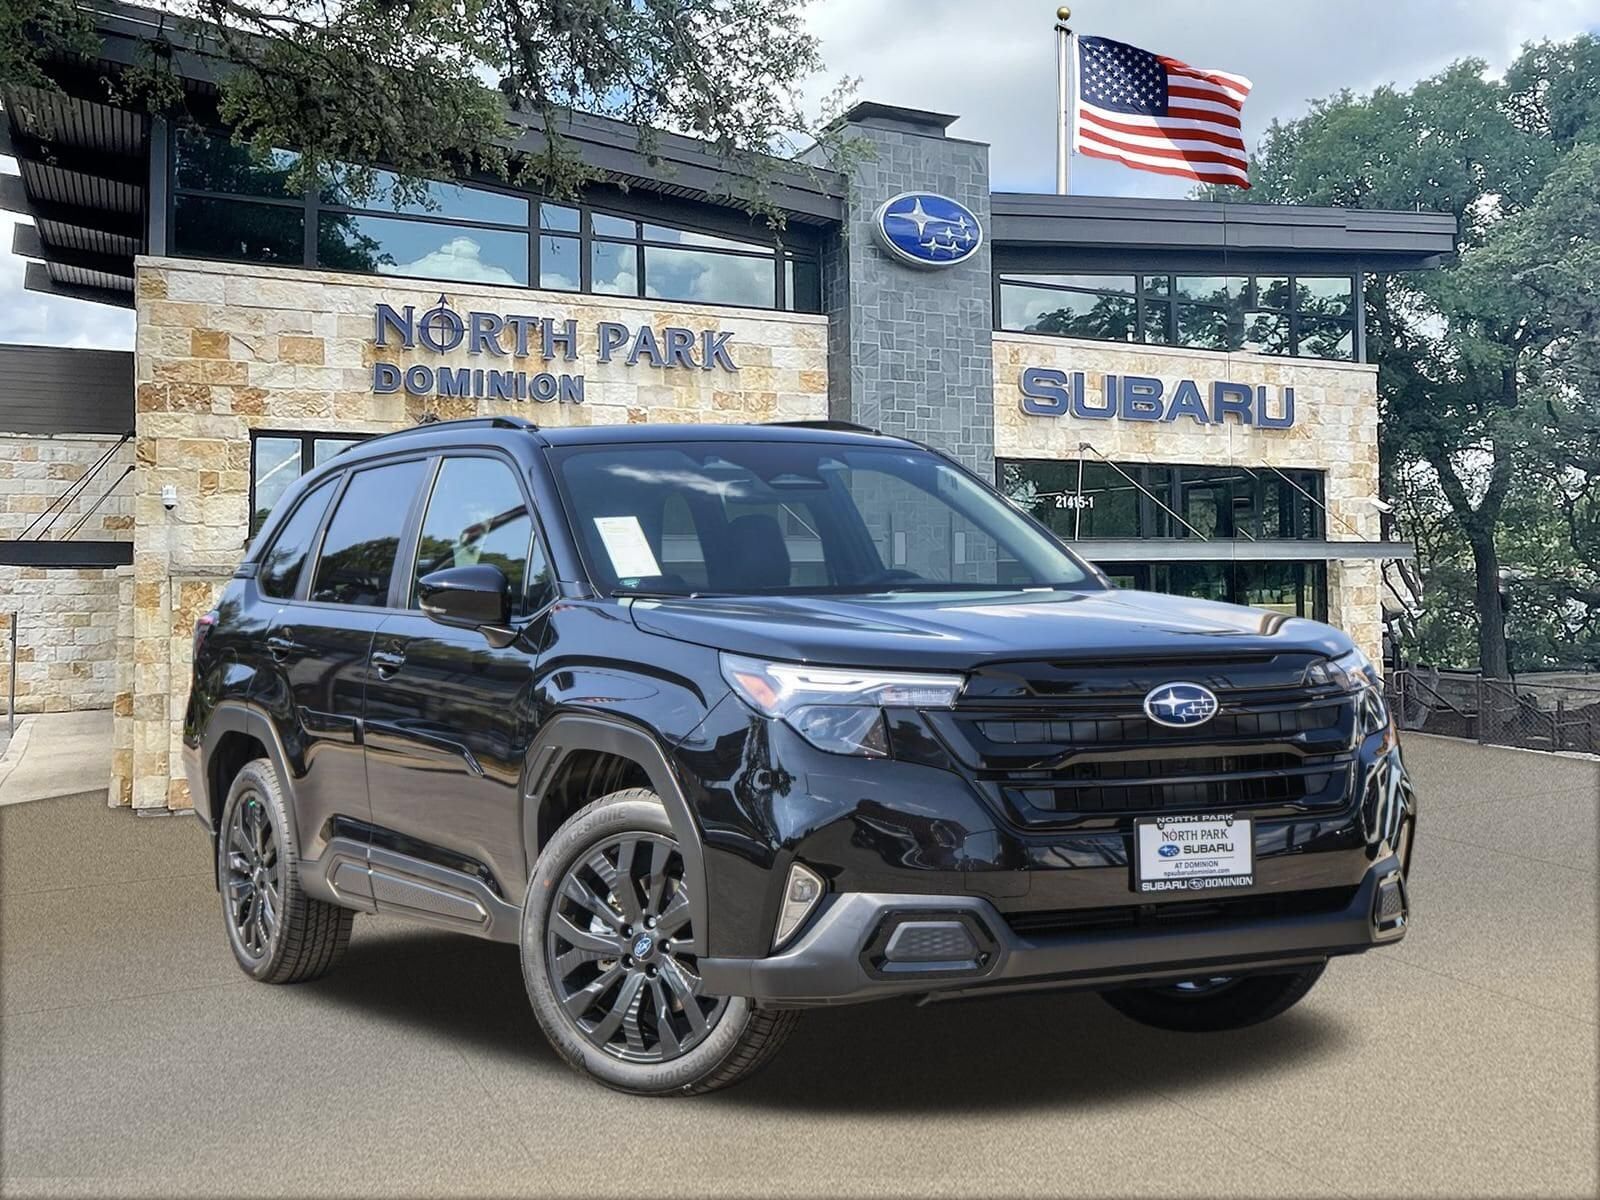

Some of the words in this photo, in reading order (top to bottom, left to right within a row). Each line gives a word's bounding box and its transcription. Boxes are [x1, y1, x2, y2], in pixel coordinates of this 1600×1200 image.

[375, 299, 579, 361] NORTH
[597, 321, 741, 373] PARK
[373, 362, 585, 405] DOMINION
[1019, 367, 1295, 430] SUBARU
[1055, 495, 1094, 509] 21415-1
[1157, 816, 1198, 824] NORTH
[1162, 829, 1198, 842] NORTH
[1200, 829, 1228, 840] PARK
[1183, 843, 1234, 854] SUBARU
[1184, 861, 1218, 869] DOMINION
[1163, 868, 1230, 877] npsubarudominion.com
[1142, 881, 1187, 892] SUBARU
[1205, 876, 1253, 888] DOMINION
